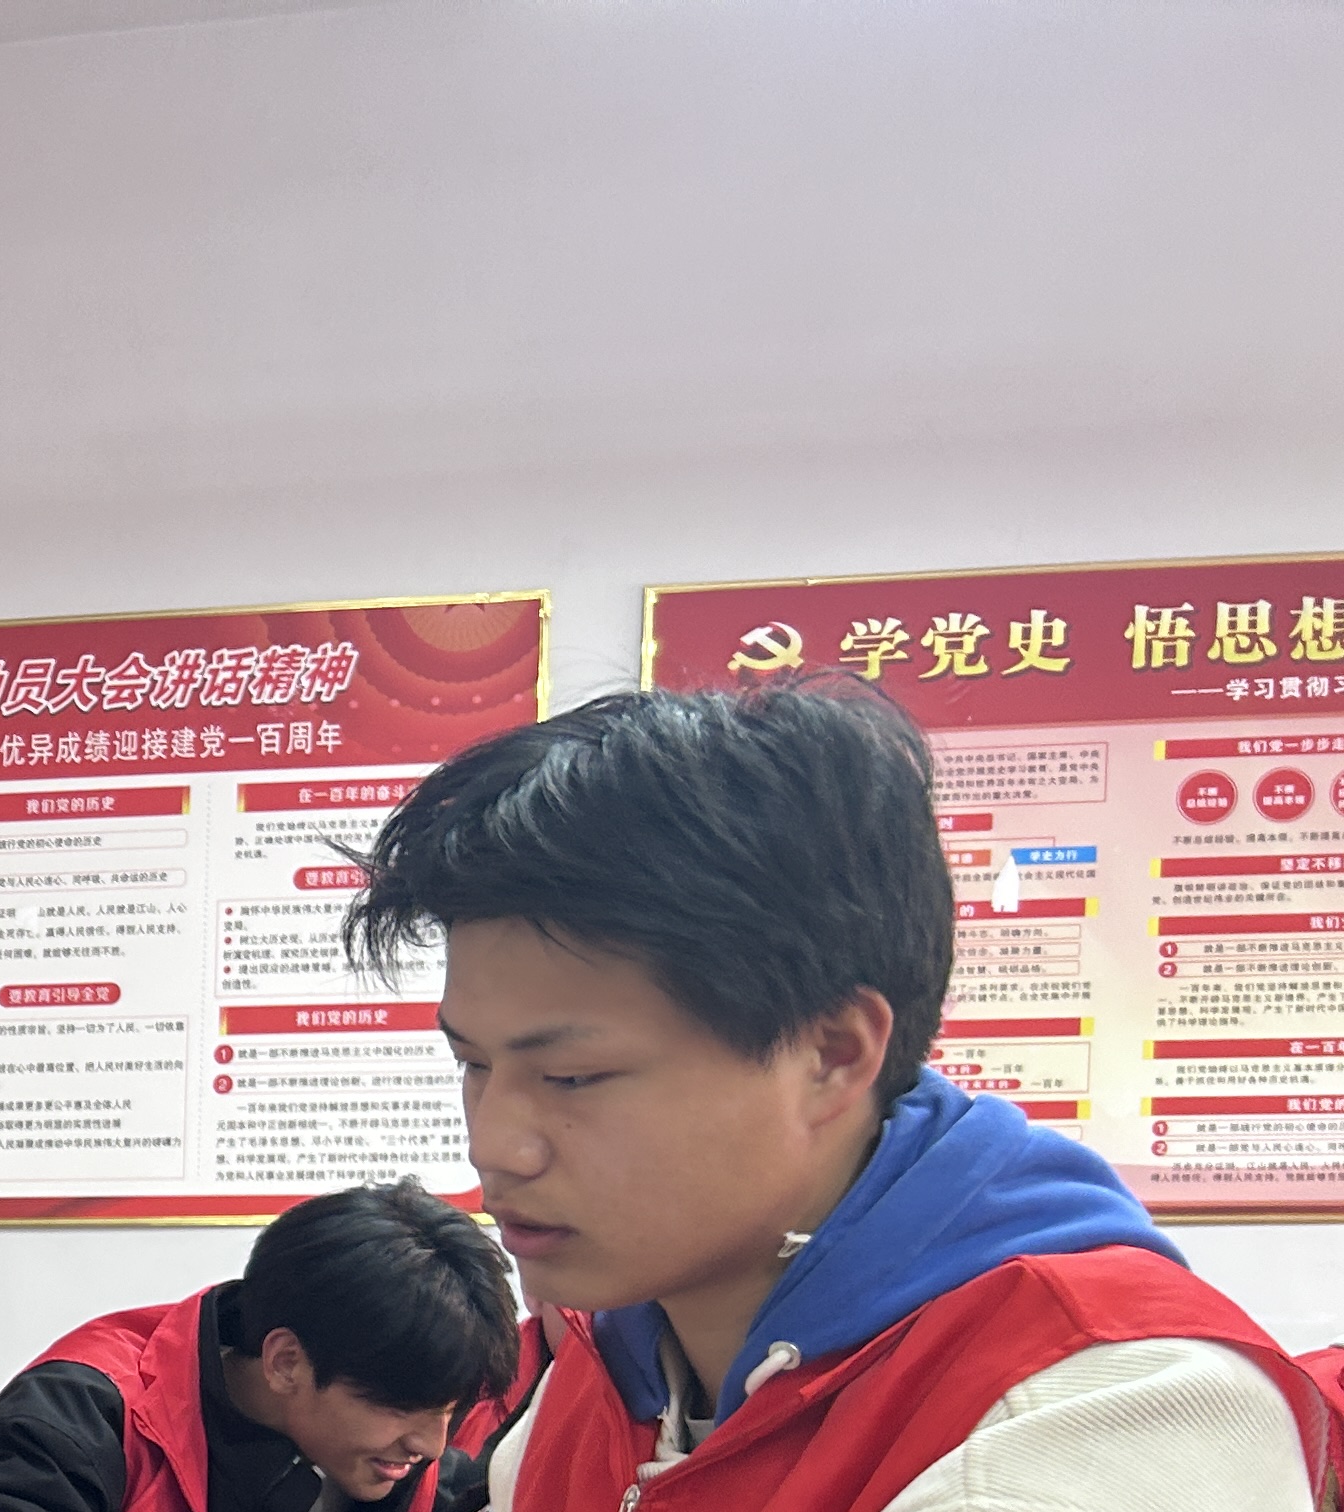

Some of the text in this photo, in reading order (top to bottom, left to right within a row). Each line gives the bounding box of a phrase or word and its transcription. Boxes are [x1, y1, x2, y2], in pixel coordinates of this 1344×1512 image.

[840, 609, 1073, 681] 学党史
[26, 796, 116, 815] 我们党的历史
[1029, 850, 1078, 862] 学史力行
[8, 985, 110, 1004] 要教育引导全党
[296, 1009, 389, 1027] 我们党的历史
